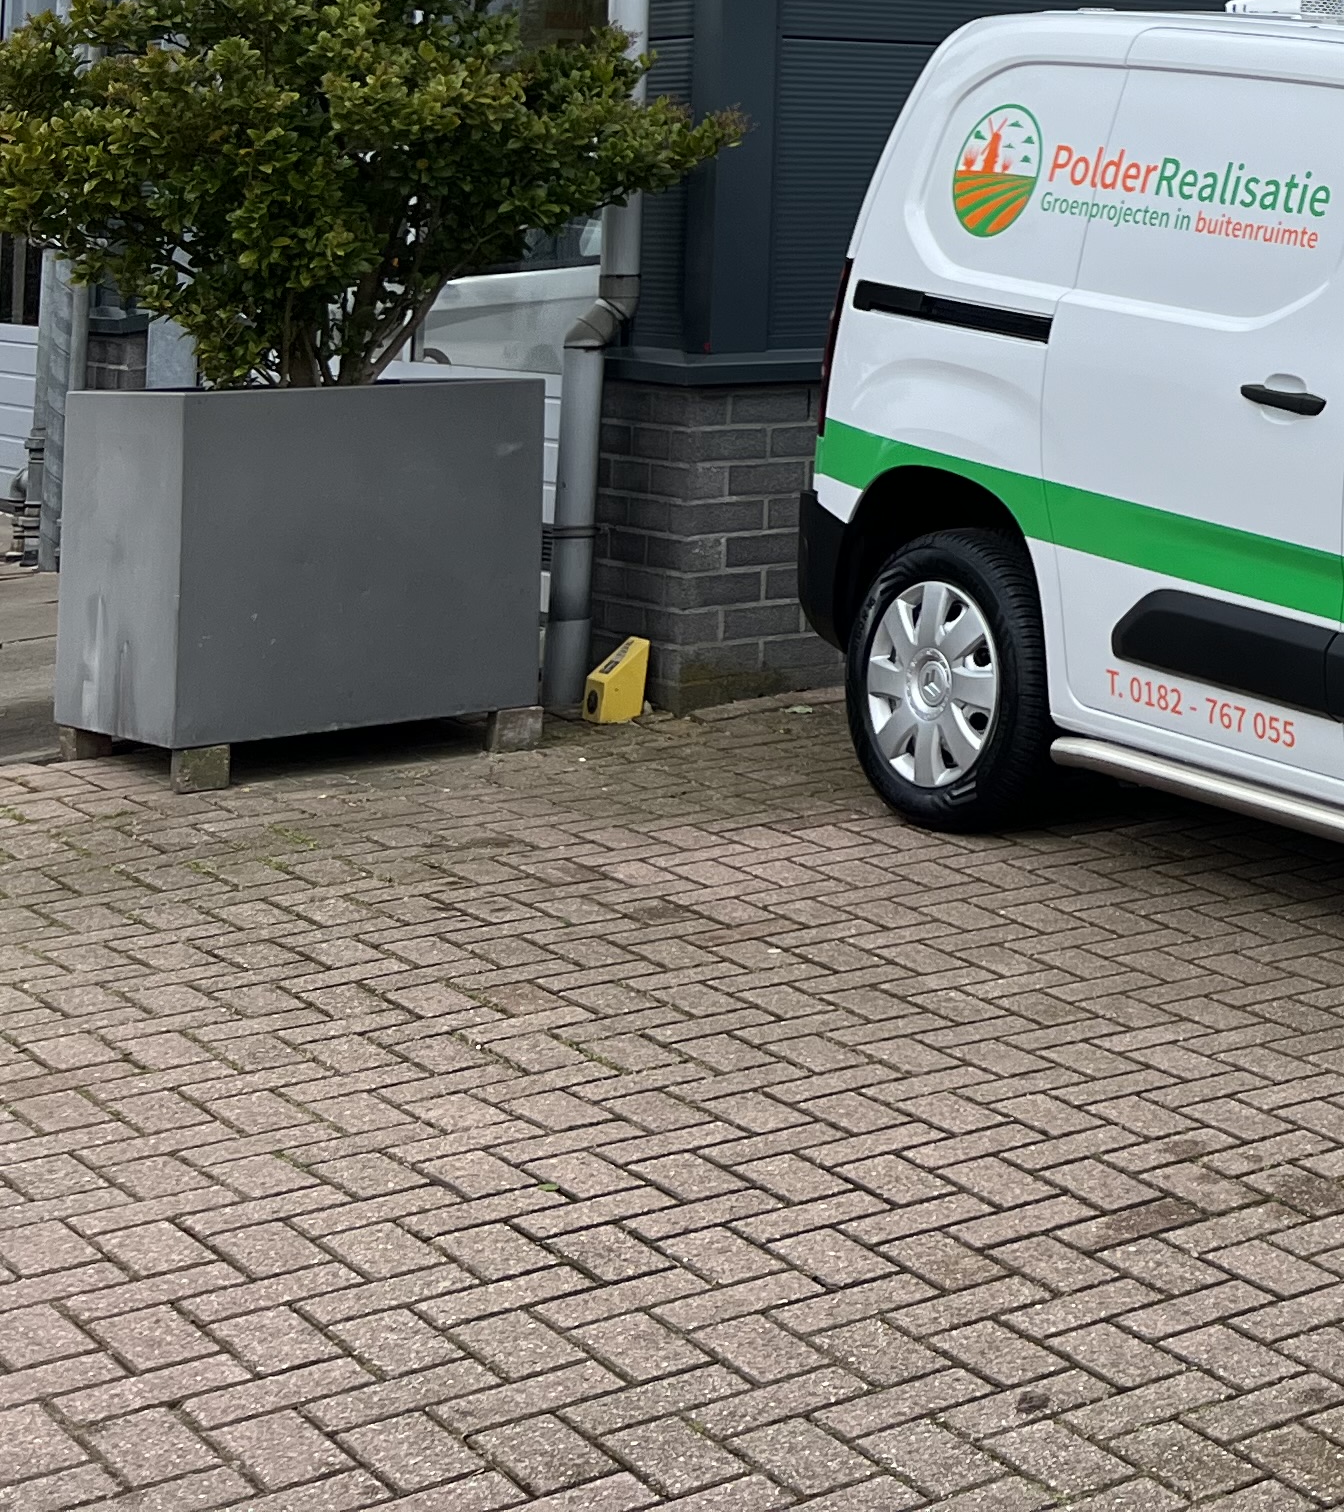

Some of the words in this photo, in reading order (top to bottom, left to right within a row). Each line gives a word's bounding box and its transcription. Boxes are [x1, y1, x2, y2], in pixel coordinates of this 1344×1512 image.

[1047, 144, 1332, 218] PolderRealisatie
[1040, 191, 1170, 230] Groenprojecten
[1174, 207, 1192, 232] in
[1195, 210, 1319, 249] buitenruimte
[1106, 669, 1124, 699] T.
[1129, 676, 1183, 716] 0182
[1205, 697, 1246, 734] 767
[1253, 709, 1296, 749] 055
